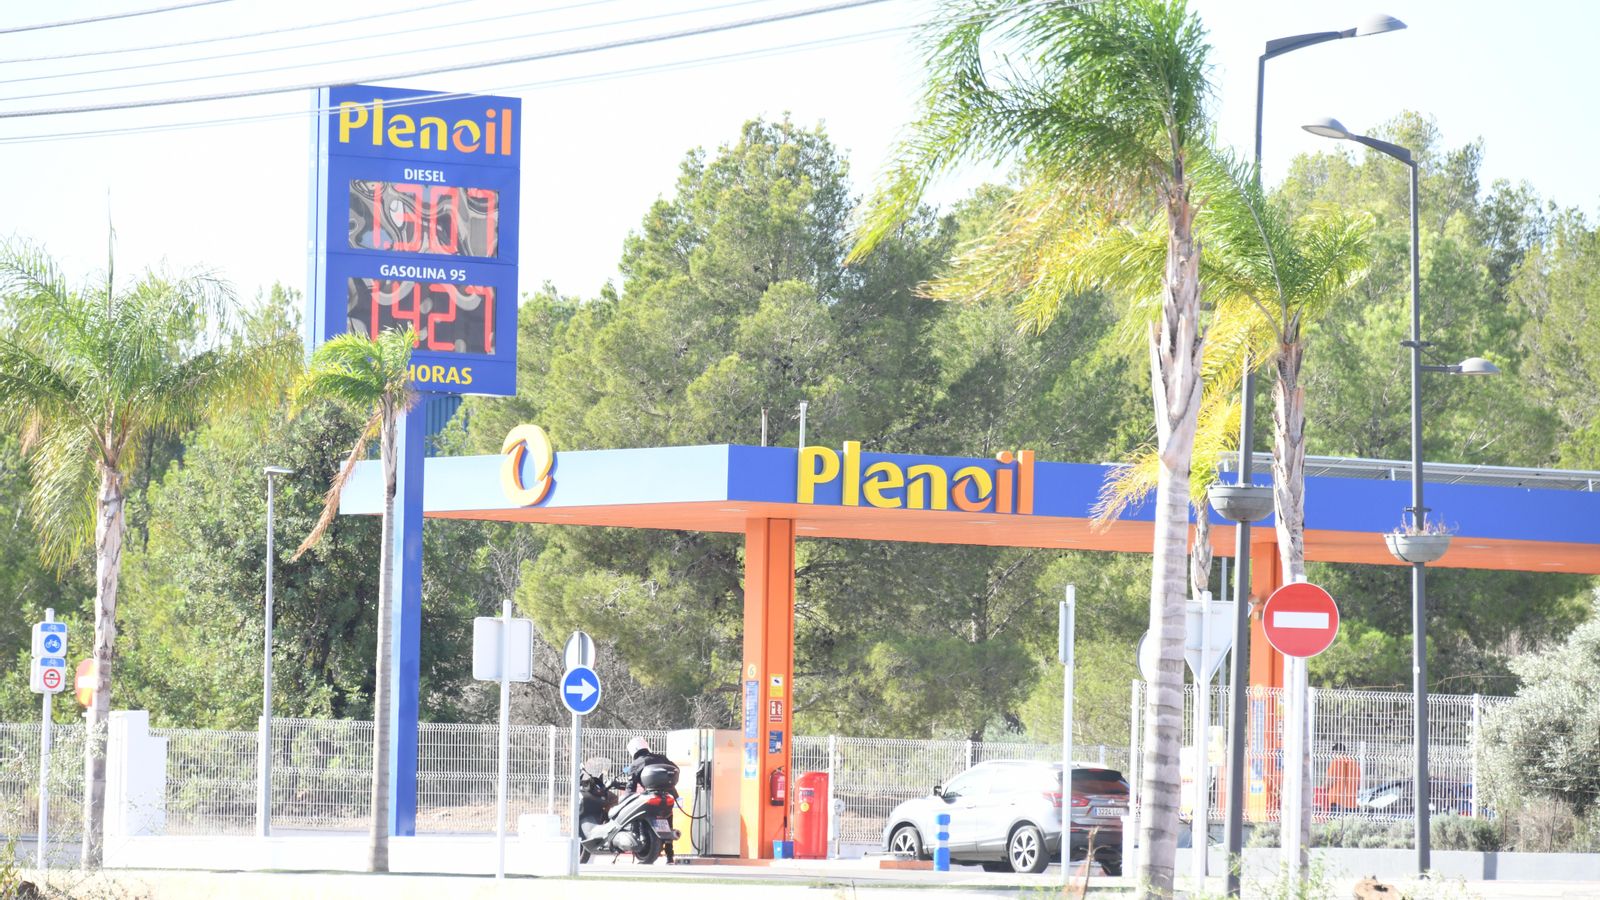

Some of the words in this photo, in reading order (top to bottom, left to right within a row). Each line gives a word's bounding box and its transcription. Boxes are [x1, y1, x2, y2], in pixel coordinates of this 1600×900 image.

[339, 98, 512, 155] Plenoil
[404, 168, 446, 183] DIESEL
[380, 265, 446, 280] GASOLINA
[450, 270, 466, 281] 95
[798, 441, 1035, 514] Plenoil
